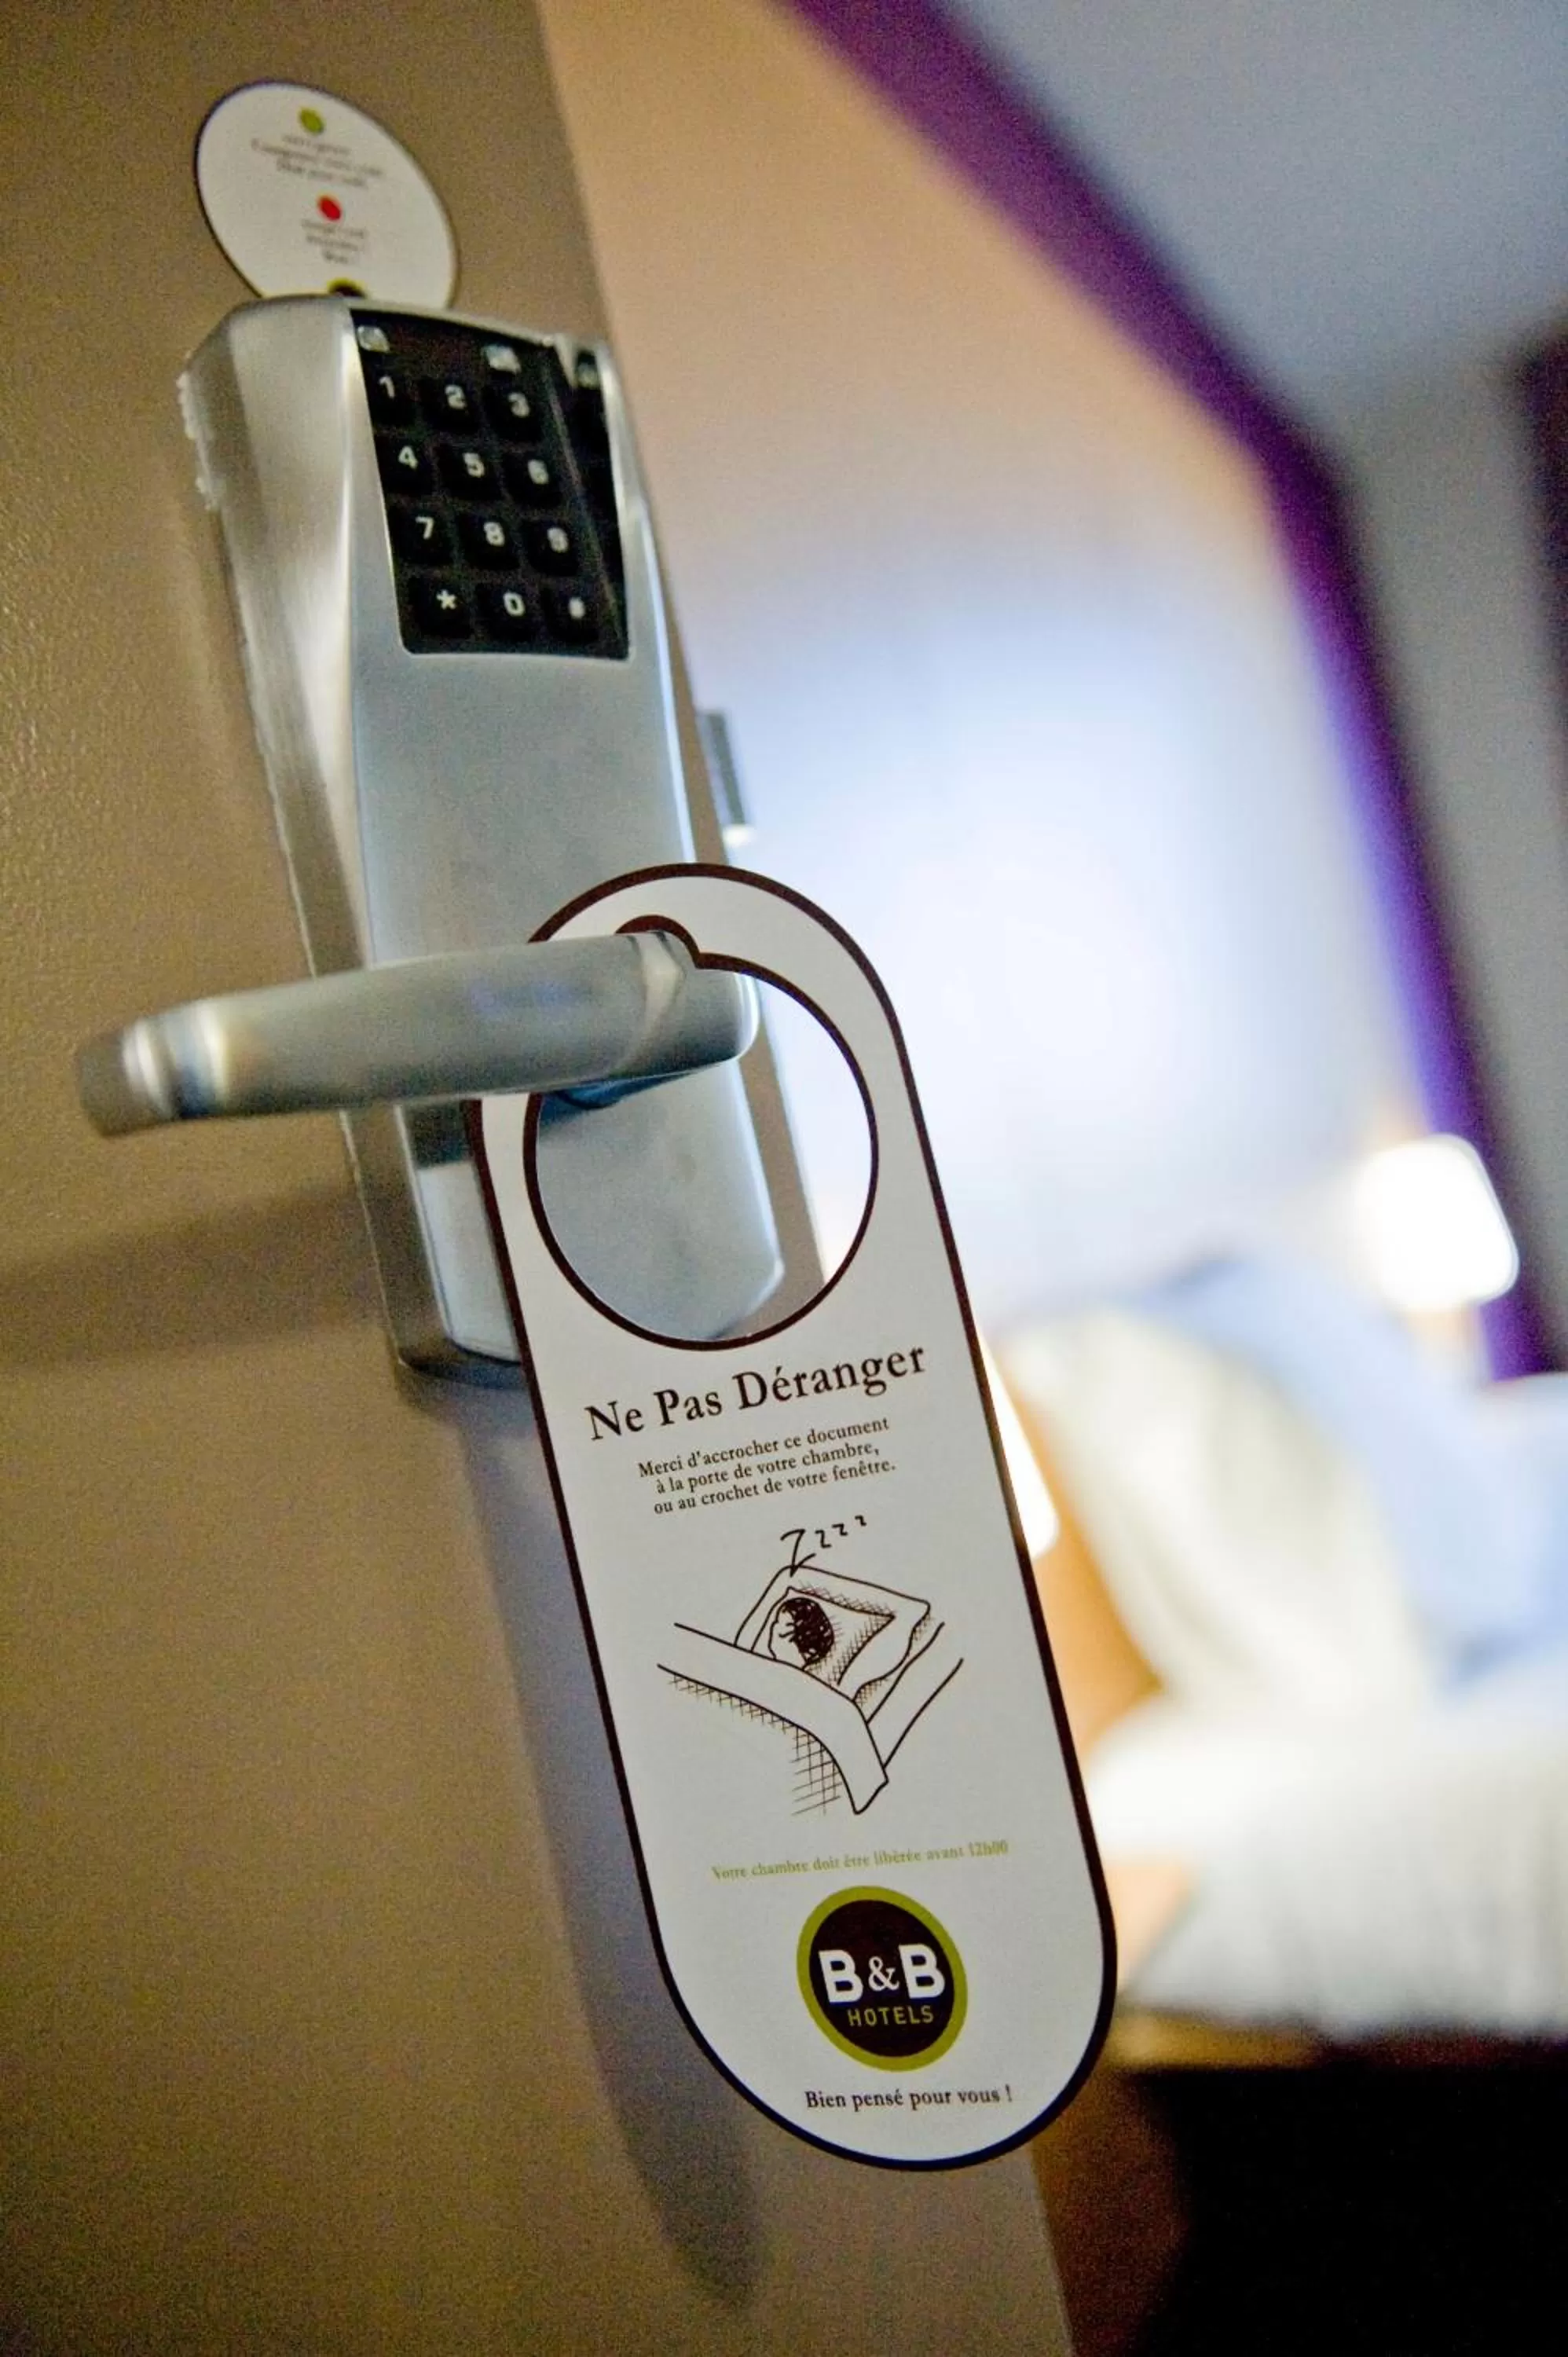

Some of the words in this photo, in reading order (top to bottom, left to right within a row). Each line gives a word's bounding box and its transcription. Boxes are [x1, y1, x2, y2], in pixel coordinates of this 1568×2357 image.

[379, 375, 394, 398] 1
[444, 384, 467, 409] 2
[508, 392, 530, 418] 3
[398, 445, 419, 470] 4
[463, 452, 485, 478] 5
[416, 516, 434, 540] 7
[482, 521, 505, 547] 8
[503, 592, 526, 617] 0
[584, 1400, 645, 1440] Ne
[654, 1387, 723, 1426] Pas
[731, 1346, 925, 1410] Déranger
[638, 1455, 683, 1478] Merci
[687, 1438, 779, 1468] d'accrocher
[784, 1435, 802, 1449] ce
[807, 1417, 890, 1446] document
[654, 1501, 673, 1515] ou
[678, 1497, 696, 1510] au
[701, 1483, 760, 1505] crochet
[764, 1478, 782, 1494] de
[787, 1471, 828, 1490] votre
[832, 1458, 896, 1482] fenêtre.
[656, 1479, 666, 1494] à
[669, 1475, 684, 1491] la
[688, 1471, 728, 1494] porte
[734, 1464, 753, 1479] de
[757, 1457, 797, 1476] votre
[801, 1442, 880, 1467] chambre,
[711, 1865, 746, 1880] Votre
[751, 1860, 808, 1876] chambre
[813, 1855, 841, 1871] doit
[844, 1853, 870, 1868] être
[874, 1848, 921, 1866] libérée
[927, 1846, 965, 1861] avant
[818, 1944, 945, 2003] B&B
[848, 2005, 934, 2027] HOTELS
[805, 2090, 847, 2109] Bien
[852, 2088, 903, 2112] pensé
[910, 2092, 951, 2110] pour
[958, 2088, 1000, 2105] vous
